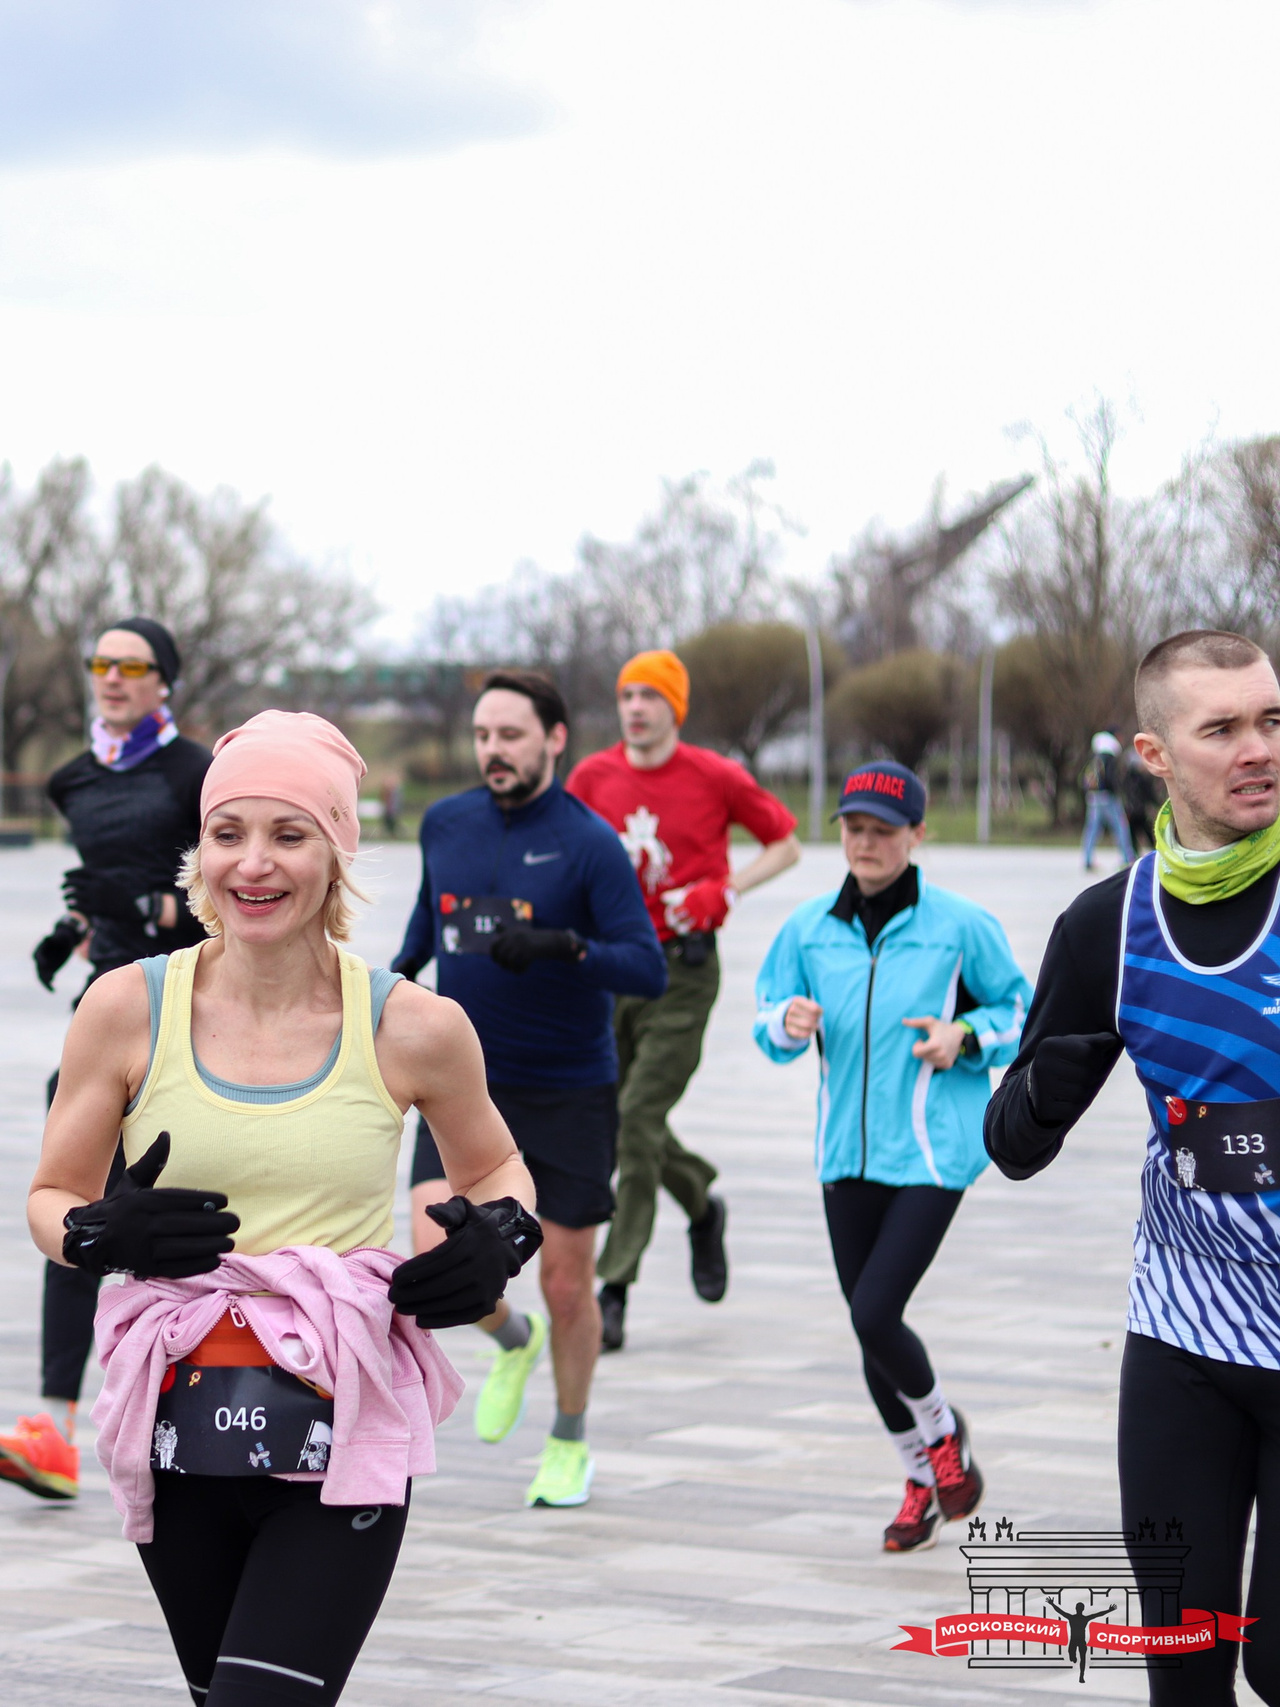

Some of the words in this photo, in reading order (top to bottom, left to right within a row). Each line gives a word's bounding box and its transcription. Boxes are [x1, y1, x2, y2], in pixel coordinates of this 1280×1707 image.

[874, 772, 906, 800] RACE
[1222, 1133, 1265, 1155] 133
[214, 1406, 267, 1432] 046
